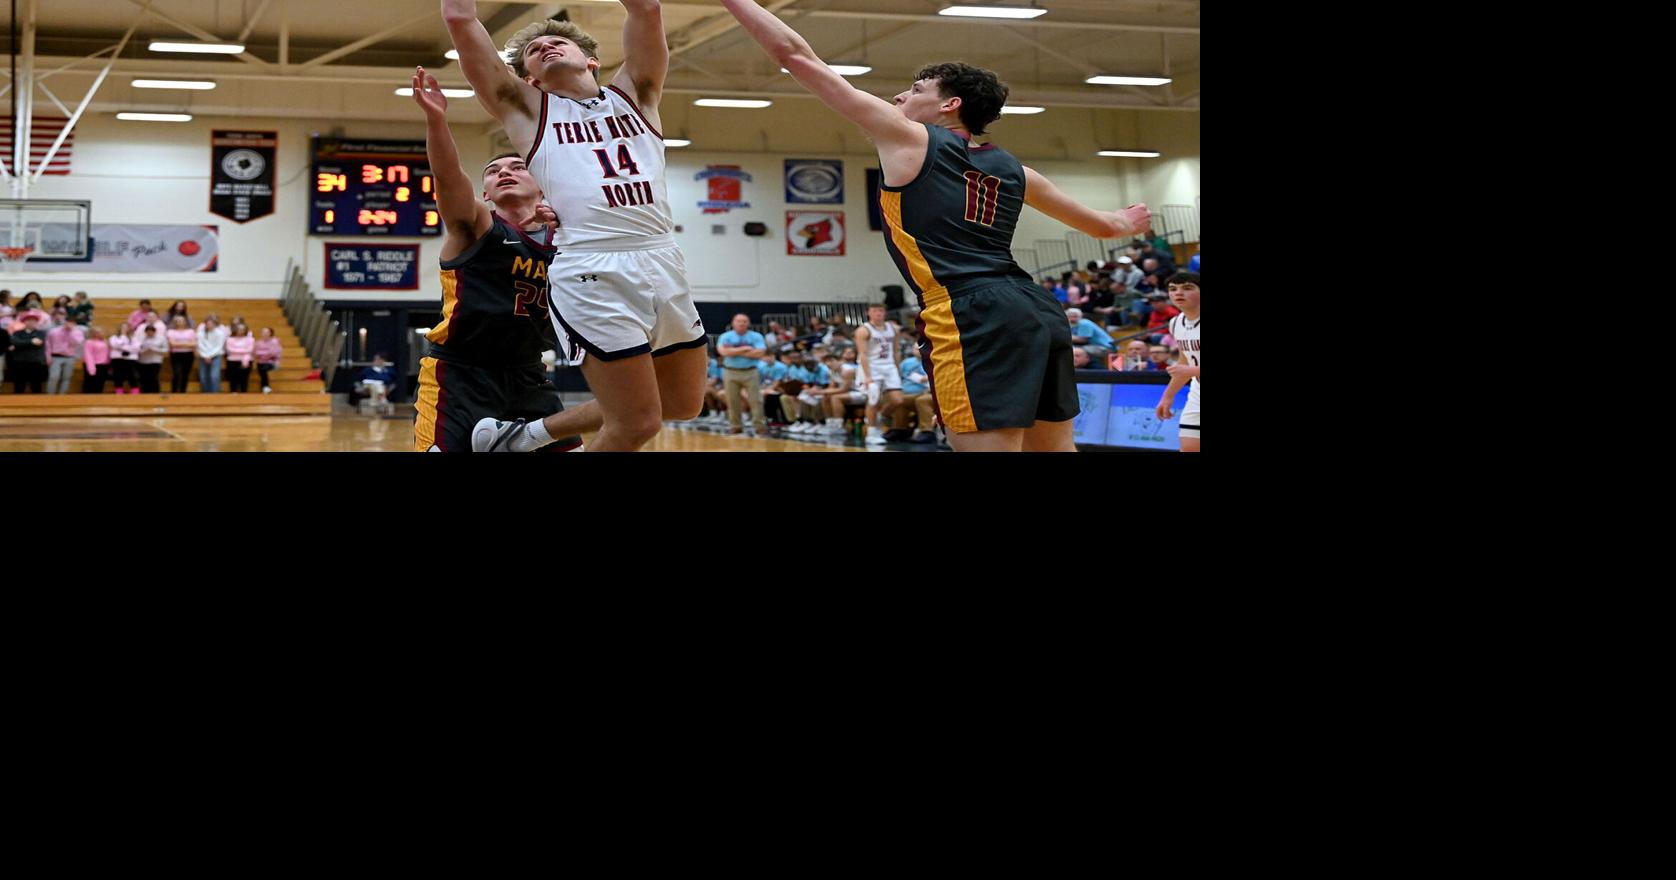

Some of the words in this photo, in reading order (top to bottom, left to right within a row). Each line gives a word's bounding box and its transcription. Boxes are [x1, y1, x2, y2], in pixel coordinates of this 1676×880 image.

[592, 143, 640, 178] 14
[317, 173, 347, 192] 34
[395, 187, 410, 202] 2
[601, 181, 654, 208] NORTH
[963, 170, 1000, 227] 11
[425, 211, 439, 226] 3
[331, 250, 359, 260] CARL
[376, 250, 414, 261] RIDDLE
[366, 262, 408, 271] PATRIOT
